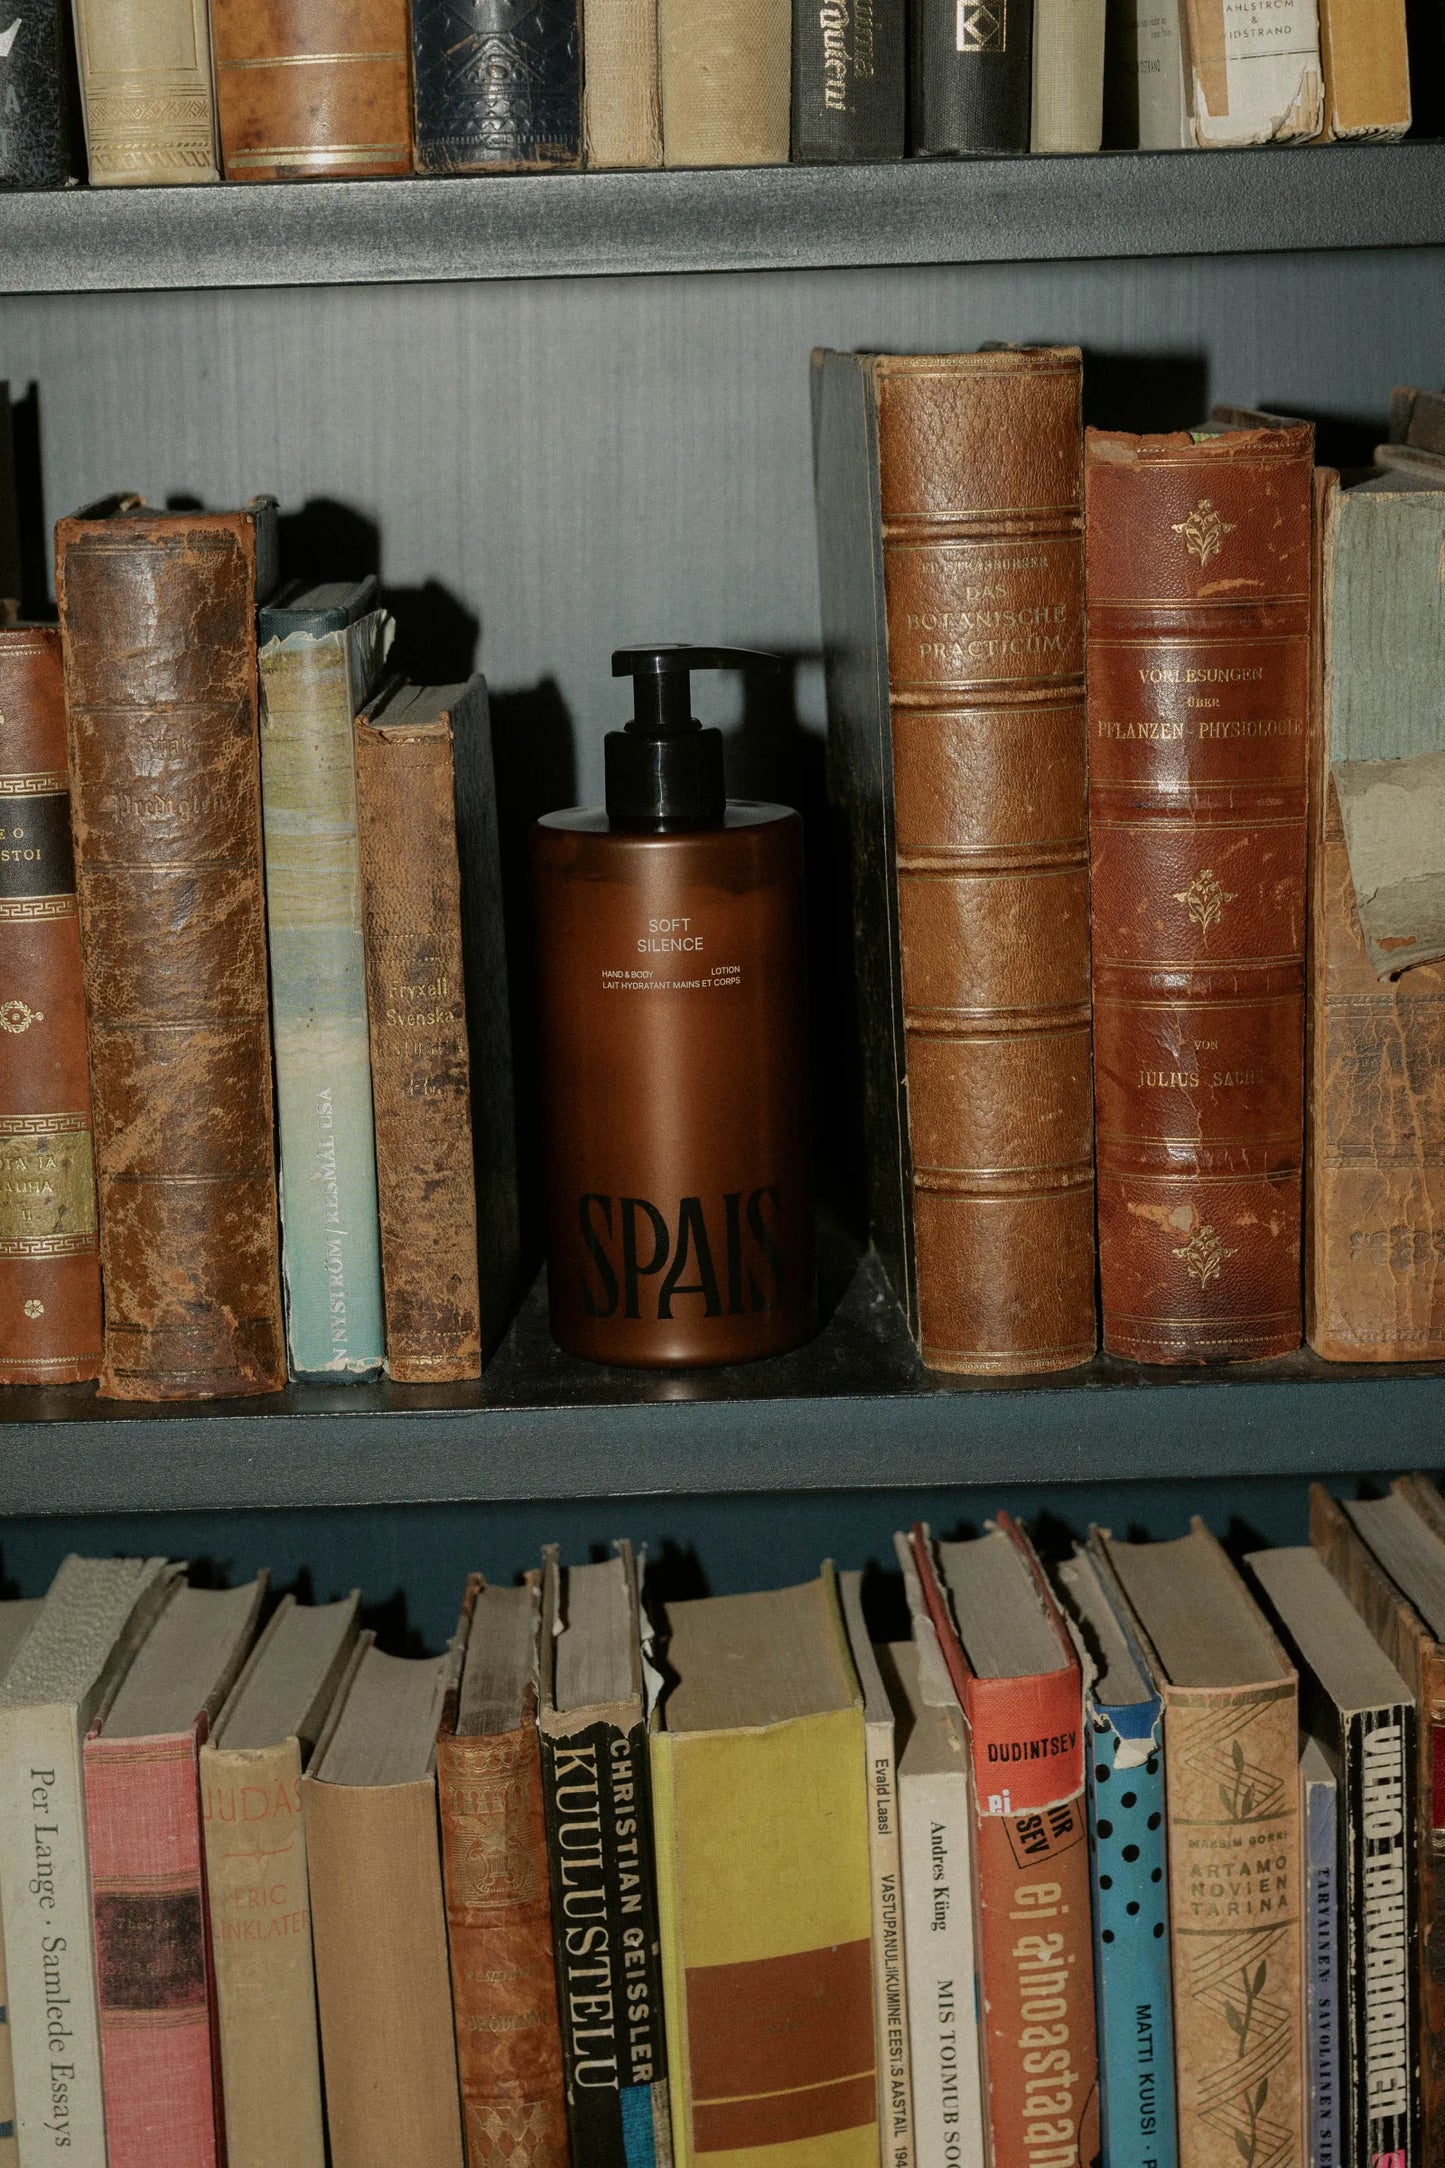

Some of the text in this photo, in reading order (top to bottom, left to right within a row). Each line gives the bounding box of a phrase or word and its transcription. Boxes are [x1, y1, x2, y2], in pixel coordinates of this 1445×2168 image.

[1225, 26, 1292, 39] IDSTRAND
[1251, 16, 1258, 24] &
[966, 584, 1007, 601] DAS
[907, 604, 1066, 630] BOTANISCHE
[920, 635, 1061, 659] PRACTICUM
[1139, 667, 1263, 683] VORLESUNGEN
[1098, 720, 1184, 740] PFLANZEN
[637, 936, 704, 953] SILENCE
[649, 918, 691, 933] SOFT
[389, 977, 448, 999] Fryxell
[602, 970, 624, 979] HAND
[631, 970, 653, 979] BODY
[711, 965, 741, 976] LOTION
[602, 976, 741, 990] LAIT HYDRATANT MAINS ET CORPS
[386, 1007, 454, 1026] Svenska
[1138, 1071, 1199, 1088] JULIUS
[315, 1087, 333, 1129] USA
[316, 1136, 340, 1224] RESMÅL
[324, 1240, 348, 1342] NYSTRÖM
[987, 1731, 1076, 1763] DUDINTSEV
[30, 1769, 55, 1814] Per
[875, 1758, 890, 1796] Evald
[1363, 1725, 1403, 1840] VILHO
[204, 1780, 304, 1821] JUDAS
[877, 1799, 892, 1835] Laasi
[931, 1821, 948, 1881] Andres
[1016, 1815, 1050, 1854] SEV
[1248, 1831, 1288, 1846] GORKI
[29, 1824, 58, 1909] Lange
[1190, 1856, 1287, 1878] ARTAMO
[234, 1884, 286, 1909] ERIC
[1009, 1882, 1070, 1920] ei
[1191, 1875, 1287, 1897] NOVIEN
[553, 1743, 619, 2091] KUULUSTELU
[610, 1738, 654, 2083] CHRISTIAN GEISSLER
[930, 1886, 950, 1932] Küng
[1190, 1894, 1288, 1917] TARINA
[41, 1936, 73, 2053] Samlede
[938, 1980, 955, 2024] MIS
[1365, 1847, 1407, 2120] TAHVANAINEN
[1136, 2004, 1154, 2063] MATTI
[940, 2030, 959, 2124] TOIMUB
[1318, 1998, 1332, 2119] SAVOLAINEN
[44, 2062, 75, 2147] Essays
[891, 2080, 908, 2138] AASTAIL
[1139, 2073, 1156, 2136] KUUSI
[1319, 2129, 1333, 2168] SIE
